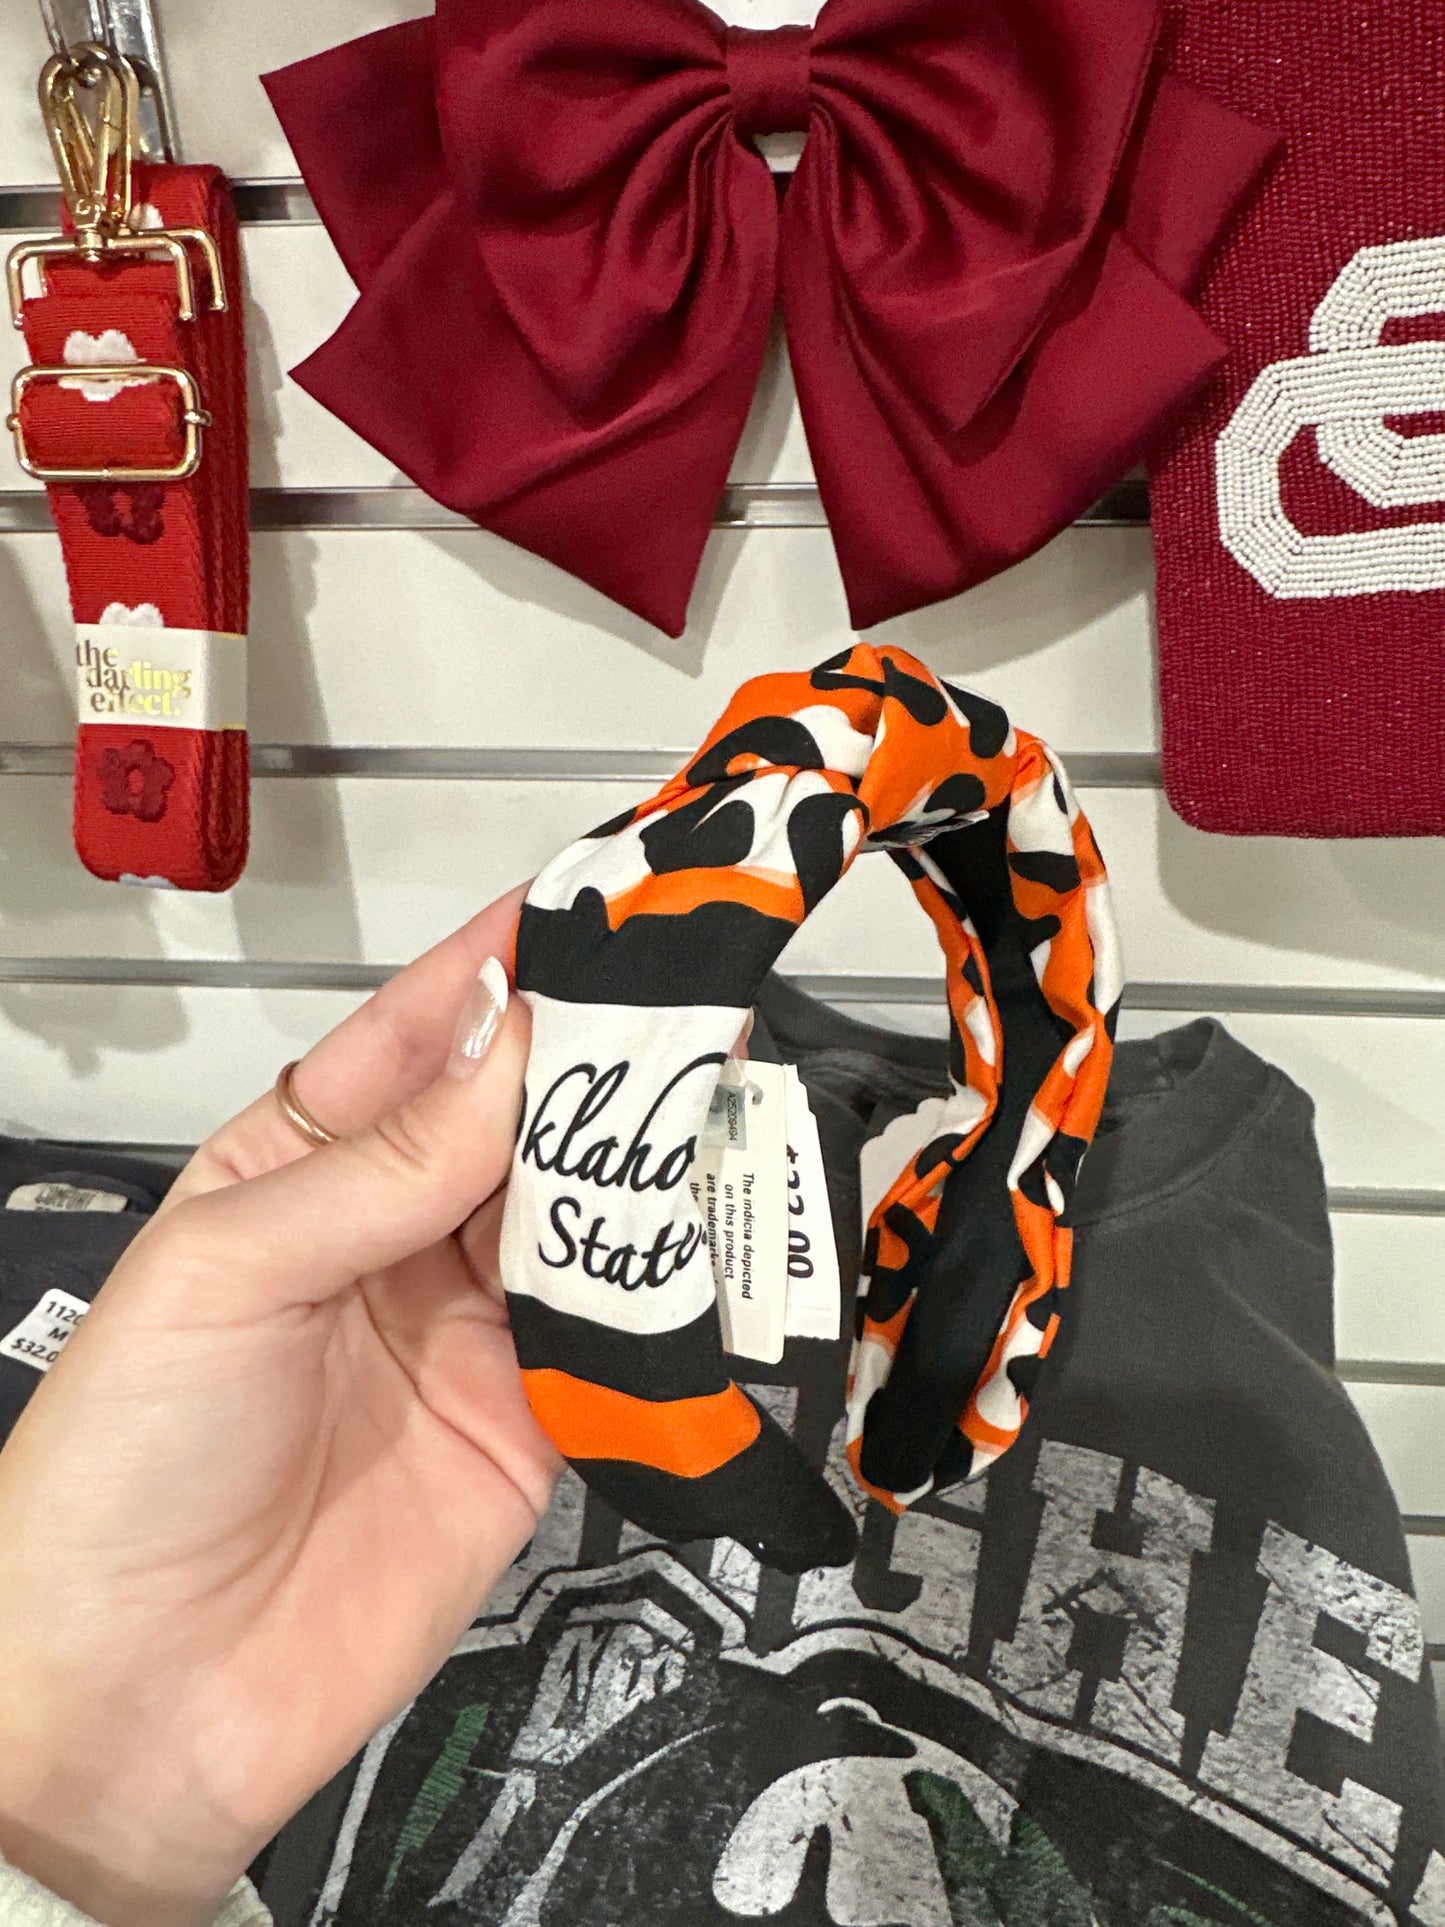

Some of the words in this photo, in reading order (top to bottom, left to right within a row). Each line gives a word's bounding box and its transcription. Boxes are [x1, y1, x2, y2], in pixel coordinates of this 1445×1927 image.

[75, 639, 118, 667] the
[86, 660, 191, 699] darling
[706, 1173, 716, 1193] are
[724, 1184, 734, 1199] on
[743, 1173, 755, 1195] The
[725, 1203, 736, 1227] this
[743, 1199, 756, 1240] indicia
[538, 1195, 708, 1291] State
[723, 1230, 736, 1279] product
[741, 1245, 755, 1300] depicted
[47, 1327, 69, 1341] M
